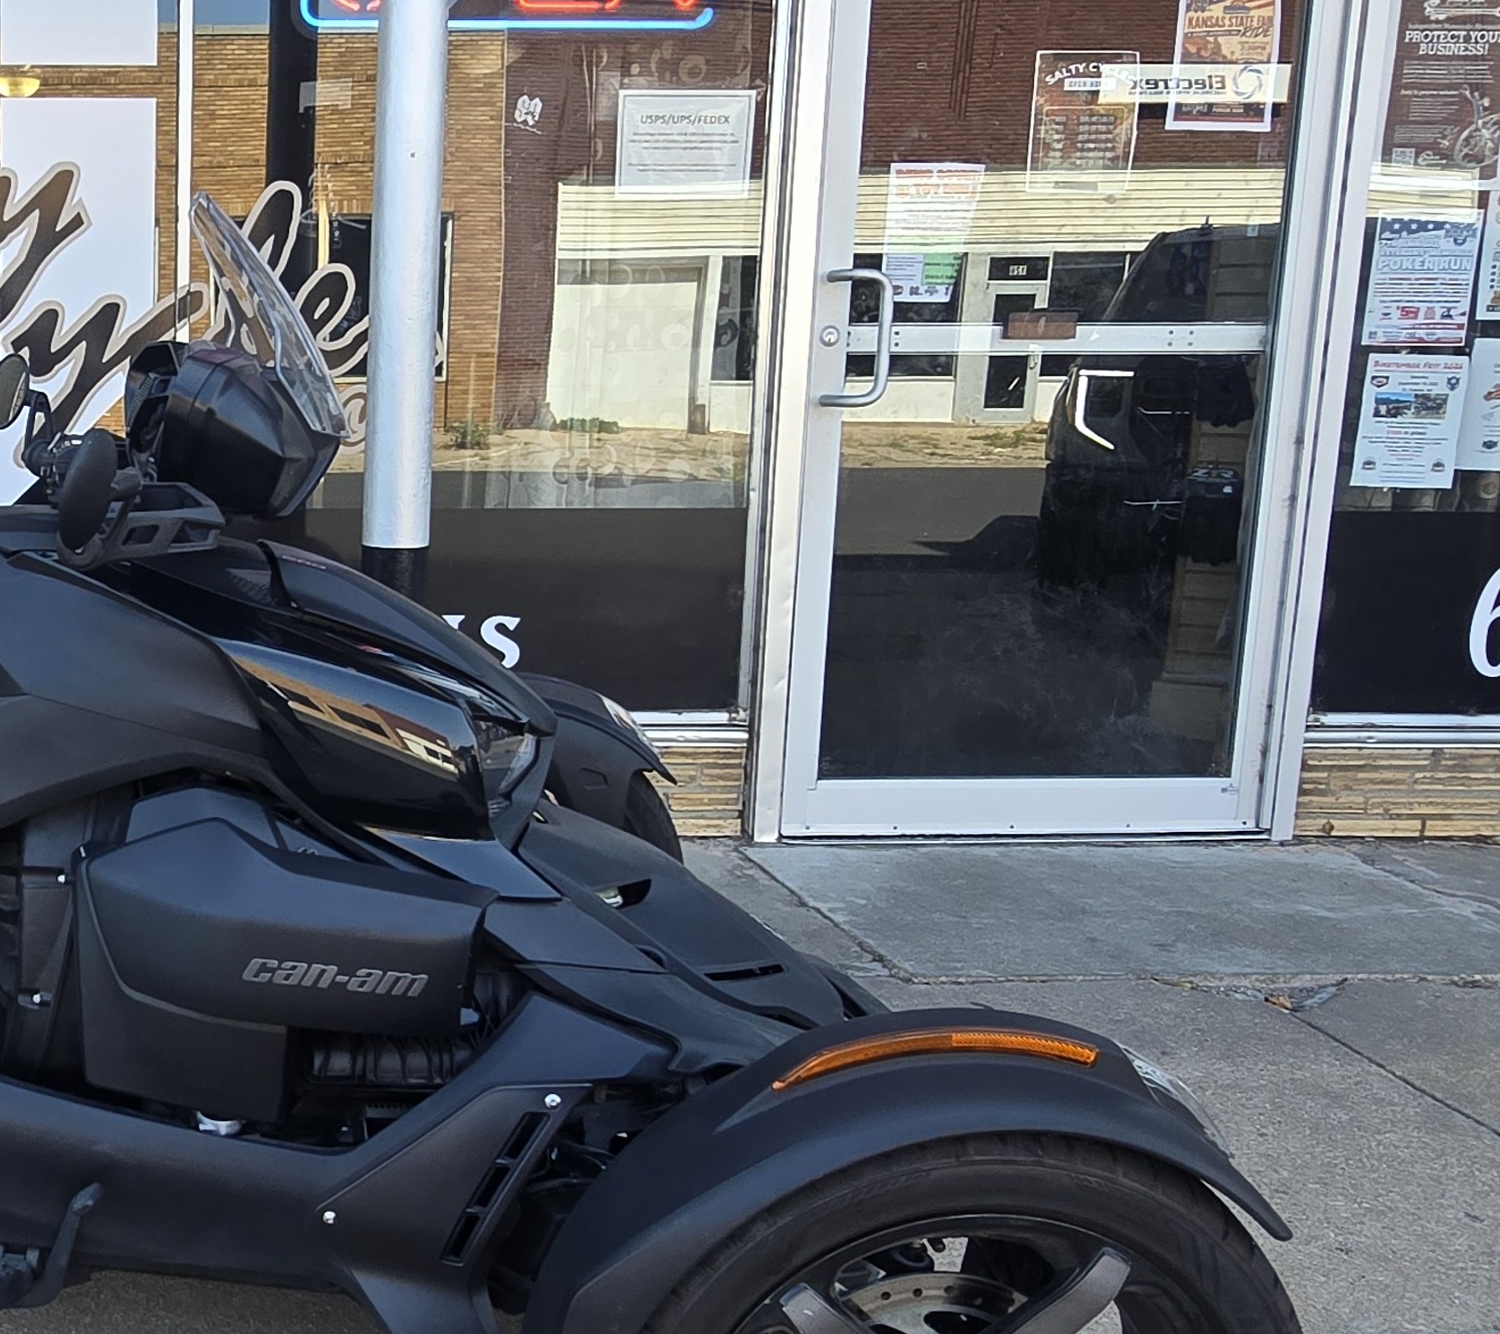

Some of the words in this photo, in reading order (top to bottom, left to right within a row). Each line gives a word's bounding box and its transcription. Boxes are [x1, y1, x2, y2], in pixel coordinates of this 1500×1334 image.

[1187, 15, 1226, 29] KANSAS
[1228, 15, 1255, 28] STATE
[1240, 27, 1272, 39] RIDE
[1404, 31, 1467, 43] PROTECT
[1419, 43, 1489, 55] BUSINESS!
[1045, 62, 1086, 85] SALTY
[640, 114, 731, 126] USPS/UPS/FEDEX
[1376, 257, 1433, 271] POKER
[1437, 256, 1474, 271] RUN
[242, 957, 429, 997] can-am
